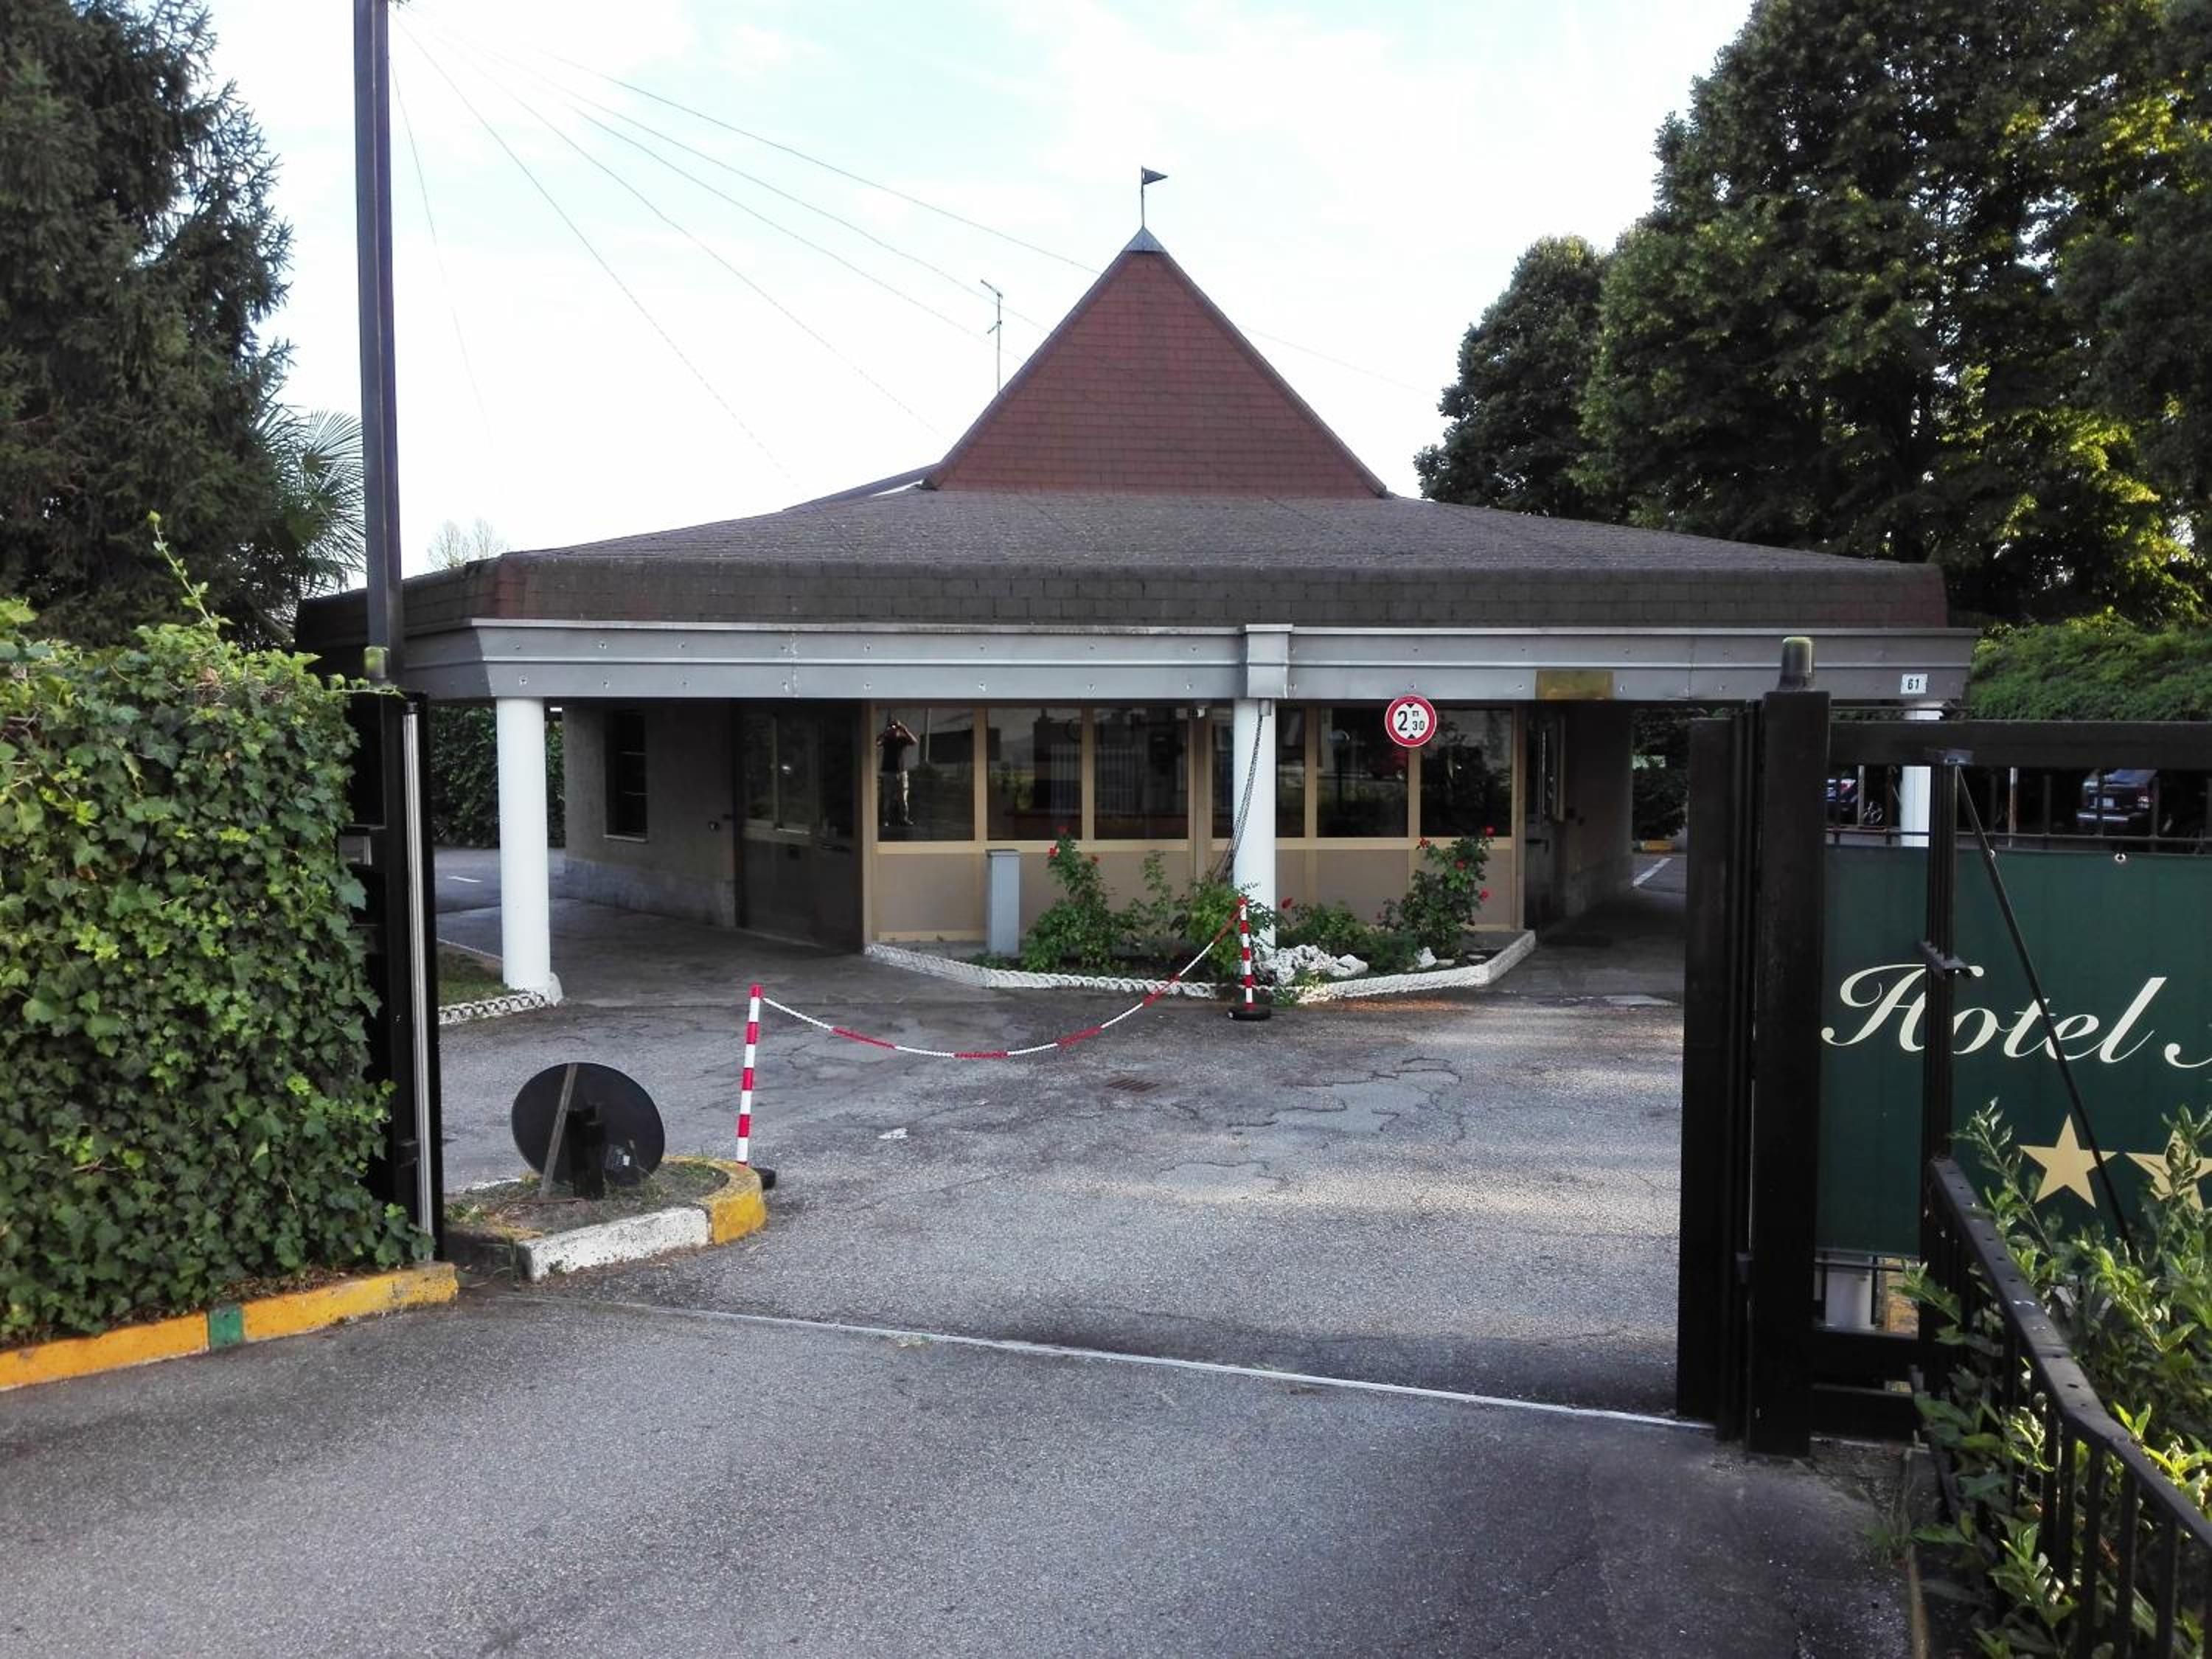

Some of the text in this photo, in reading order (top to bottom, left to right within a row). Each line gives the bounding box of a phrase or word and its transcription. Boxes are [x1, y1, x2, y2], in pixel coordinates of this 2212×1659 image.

[1907, 678, 1919, 689] 61
[1398, 711, 1408, 731] 2
[1413, 720, 1425, 731] 30
[1820, 963, 2168, 1065] Hotel
